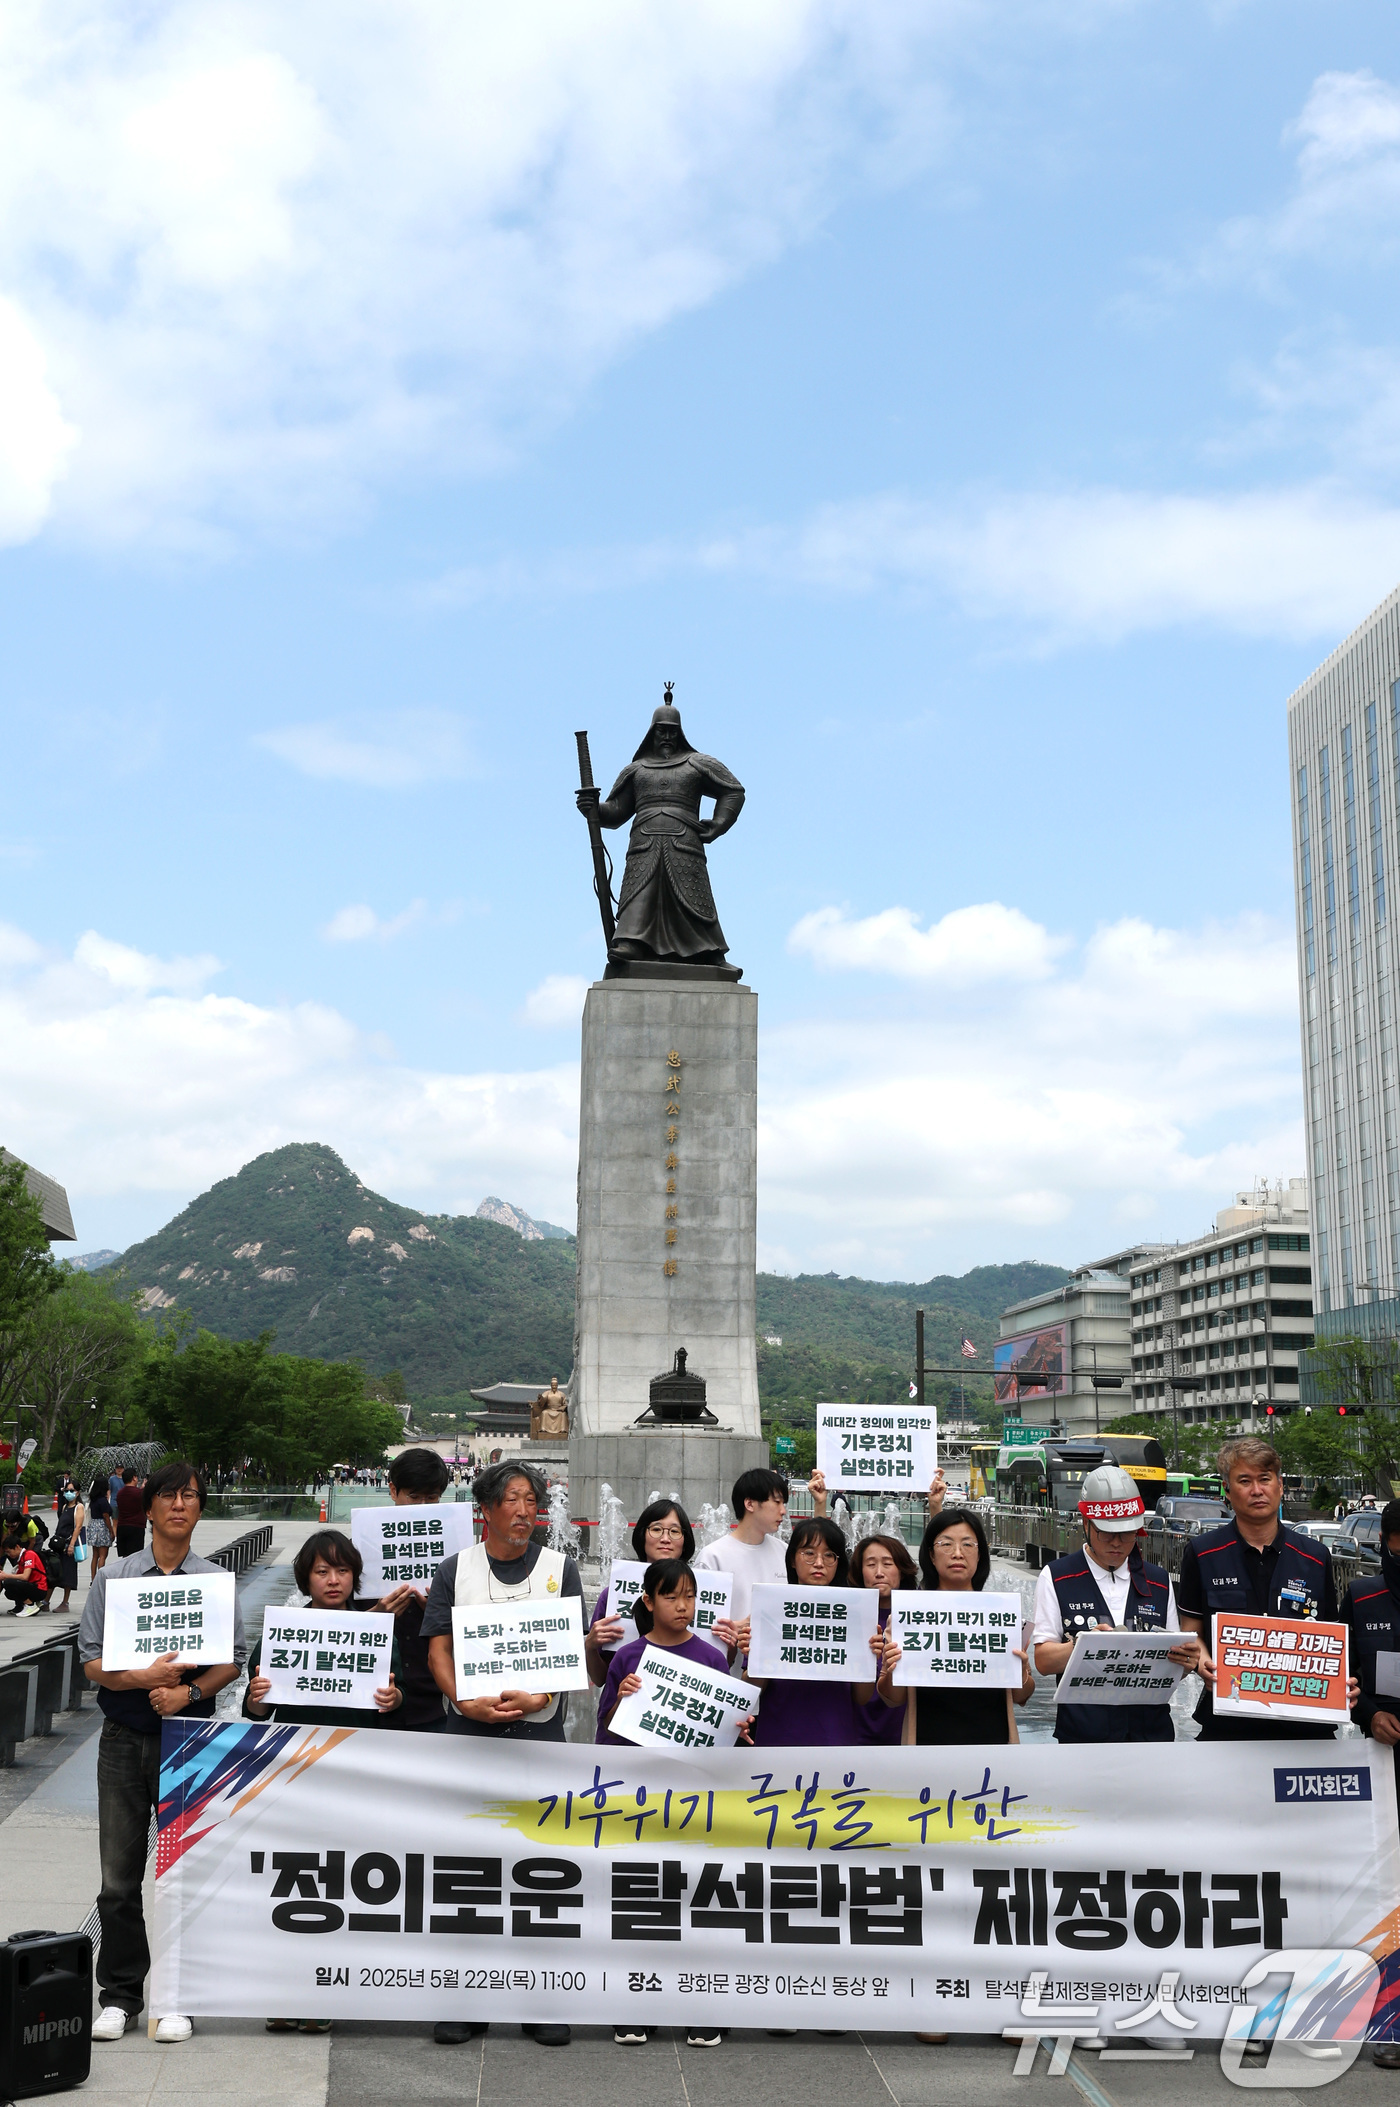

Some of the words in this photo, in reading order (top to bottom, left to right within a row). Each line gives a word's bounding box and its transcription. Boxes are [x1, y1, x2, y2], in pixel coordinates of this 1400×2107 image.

[822, 1417, 857, 1427] 세대간
[861, 1418, 893, 1428] 정의에
[898, 1418, 931, 1429] 입각한
[842, 1434, 911, 1452] 기후정치
[840, 1459, 914, 1477] 실현하라
[1066, 1471, 1091, 1481] 17
[382, 1520, 442, 1538] 정의로운
[382, 1541, 444, 1559] 탈석탄법
[138, 1589, 202, 1609] 정의로운
[700, 1591, 726, 1605] 위한
[784, 1602, 847, 1619] 정의로운
[899, 1611, 952, 1625] 기후위기
[957, 1612, 983, 1626] 막기
[989, 1613, 1016, 1626] 위한
[137, 1612, 202, 1631] 탈석탄법
[464, 1624, 504, 1639] 노동자
[519, 1618, 569, 1633] 지역민이
[269, 1628, 323, 1643] 기후위기
[328, 1631, 354, 1645] 막기
[360, 1633, 388, 1647] 위한
[782, 1624, 847, 1642] 탈석탄법
[903, 1632, 940, 1651] 조기
[948, 1633, 1008, 1653] 탈석탄
[1220, 1626, 1265, 1647] 모두의
[1267, 1630, 1298, 1650] 삶을
[1299, 1634, 1343, 1654] 지키는
[135, 1634, 204, 1654] 제정하라
[494, 1640, 547, 1655] 주도하는
[270, 1649, 308, 1670] 조기
[316, 1651, 377, 1673] 탈석탄
[780, 1647, 847, 1665] 제정하라
[1083, 1650, 1120, 1660] 노동자
[1133, 1649, 1171, 1660] 지역민
[1224, 1648, 1340, 1676] 공공재생에너지로
[464, 1654, 579, 1676] 탈석탄-에너지전환
[931, 1658, 986, 1673] 추진하라
[1103, 1664, 1151, 1673] 주도하는
[296, 1677, 352, 1693] 추진하라
[643, 1659, 678, 1682] 세대간
[679, 1673, 714, 1697] 정의에
[713, 1687, 751, 1712] 입각한
[1070, 1677, 1174, 1688] 탈석탄-에너지전환
[1240, 1672, 1287, 1694] 일자리
[1290, 1677, 1329, 1699] 전환!
[651, 1684, 725, 1729] 기후정치
[1286, 1775, 1360, 1796] 기자회견
[538, 1765, 715, 1849] 기후위기
[746, 1771, 893, 1851] 극복을
[908, 1767, 1029, 1845] 위한
[973, 1868, 1288, 1950] 제정하라
[316, 1967, 349, 1986] 일시
[360, 1968, 424, 1987] 2025년
[431, 1970, 458, 1988] 5월
[465, 1970, 535, 1990] 22일(목)
[541, 1972, 585, 1990] 11:00
[629, 1973, 662, 1992] 장소
[678, 1974, 729, 1993] 광화문
[735, 1975, 769, 1994] 광장
[776, 1976, 826, 1995] 이순신
[833, 1977, 867, 1996] 동상
[872, 1978, 889, 1996] 앞
[936, 1979, 969, 1998] 주최
[985, 1979, 1248, 2005] 탈석탄법제정을위한시민사회연대
[23, 2012, 83, 2045] MIPRO
